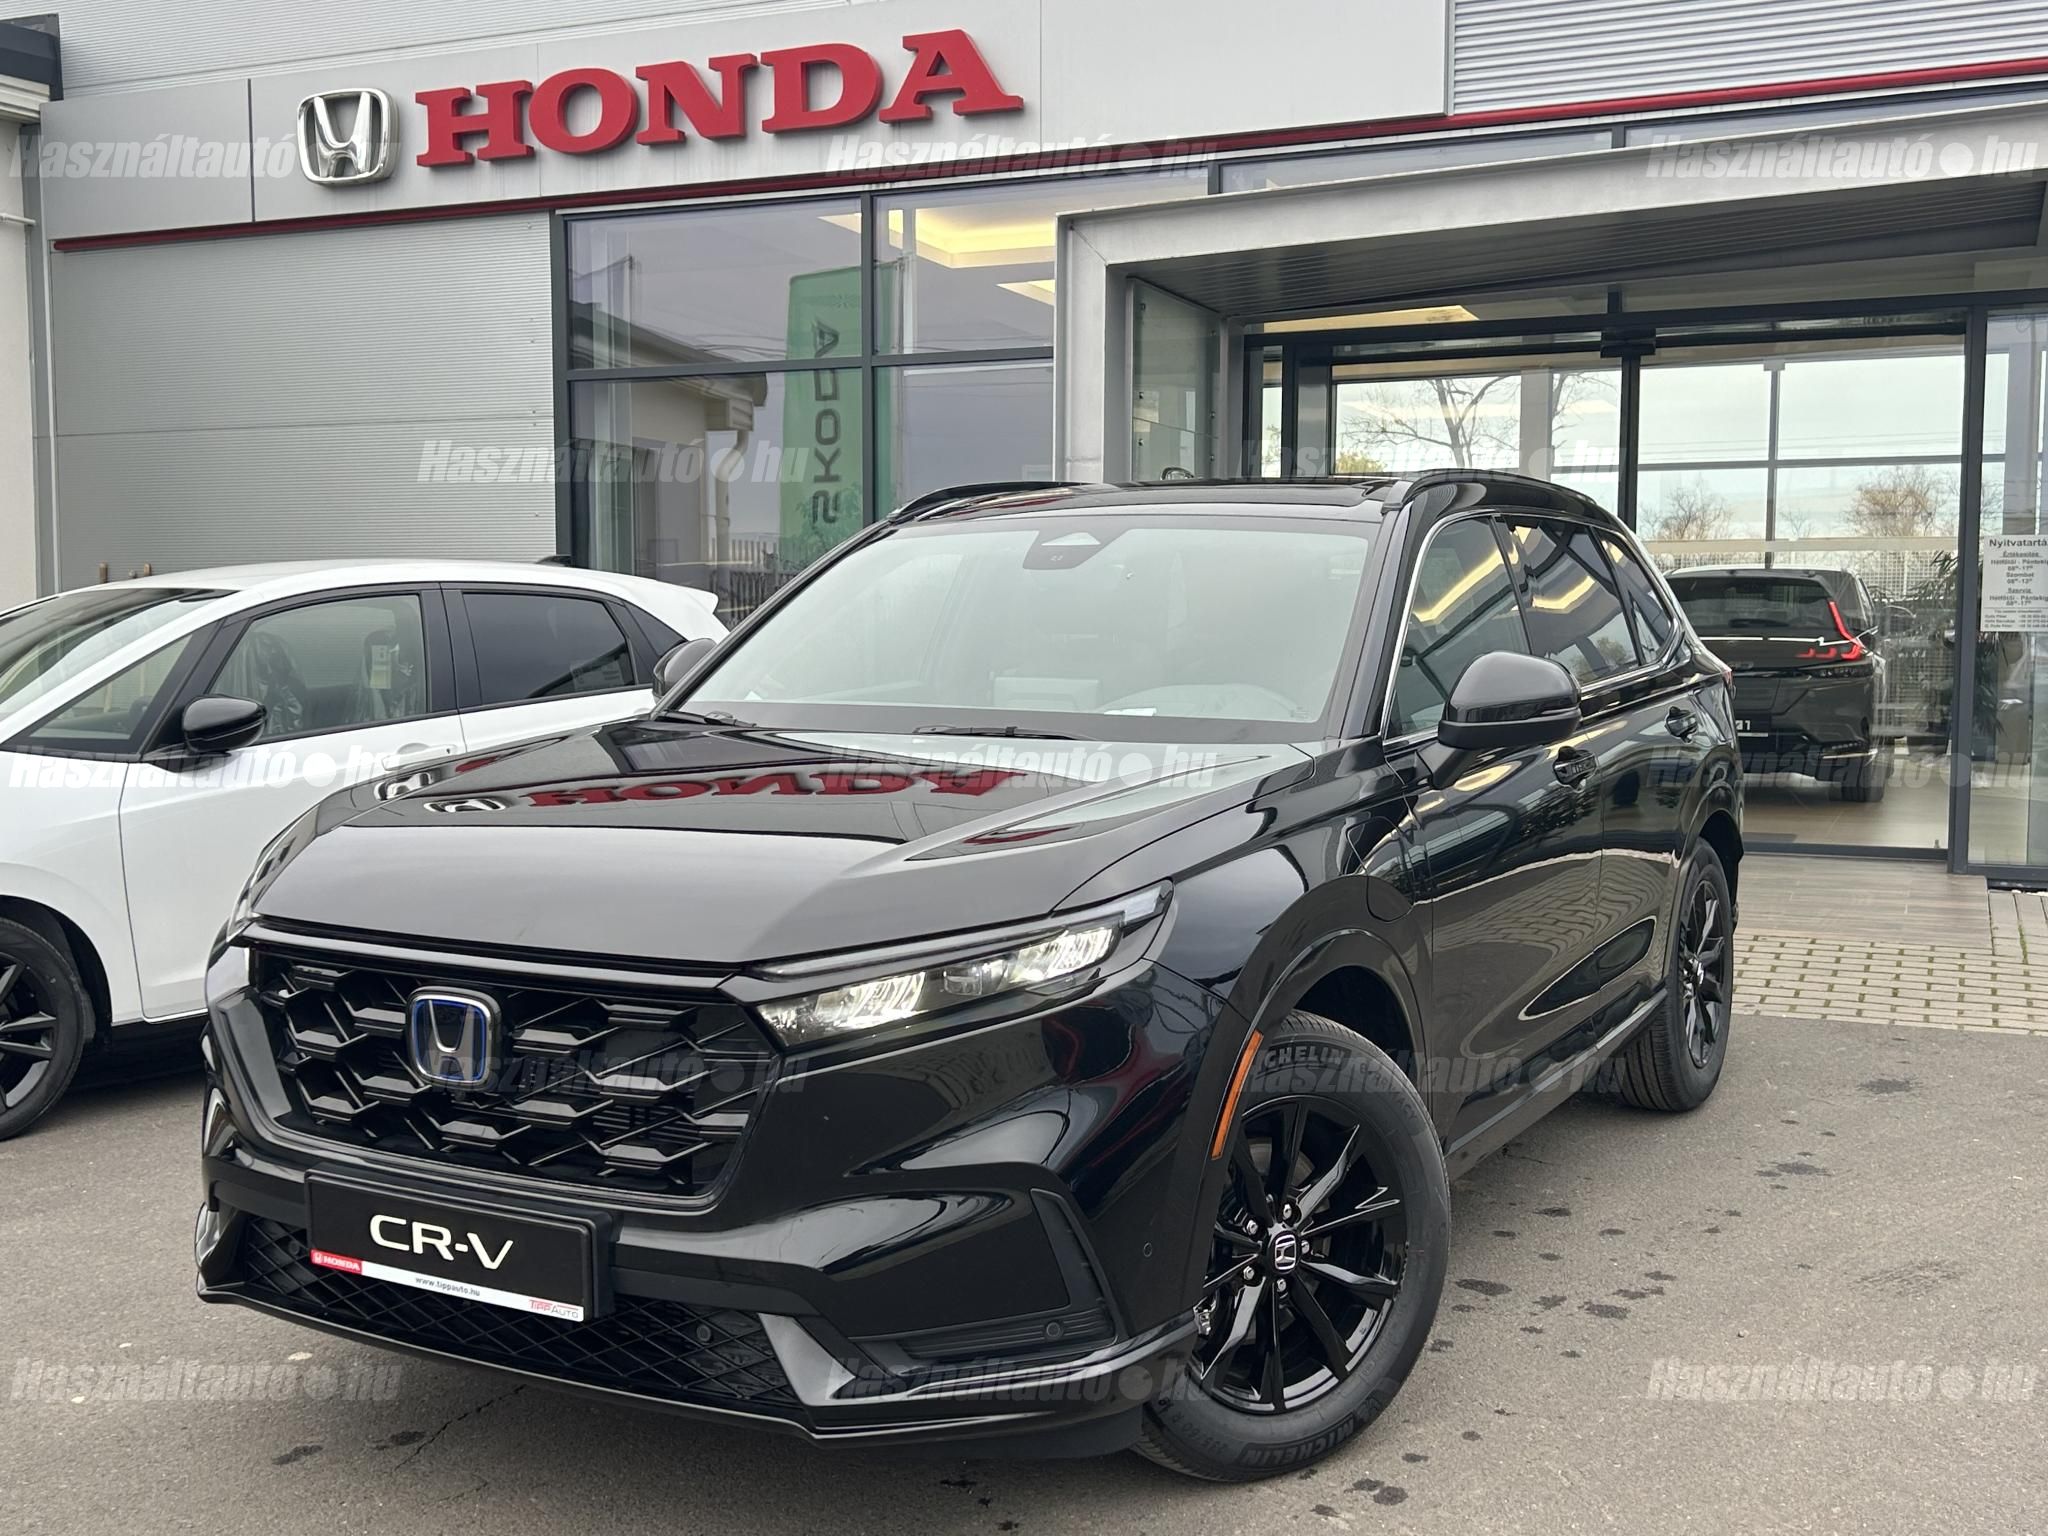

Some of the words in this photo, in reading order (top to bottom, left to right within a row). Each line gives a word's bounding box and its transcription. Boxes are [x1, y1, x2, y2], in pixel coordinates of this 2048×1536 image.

[415, 28, 1024, 168] HONDA
[369, 1213, 514, 1270] CR-V
[323, 1255, 361, 1273] HONDA
[415, 1276, 481, 1297] www.tippauto.hu
